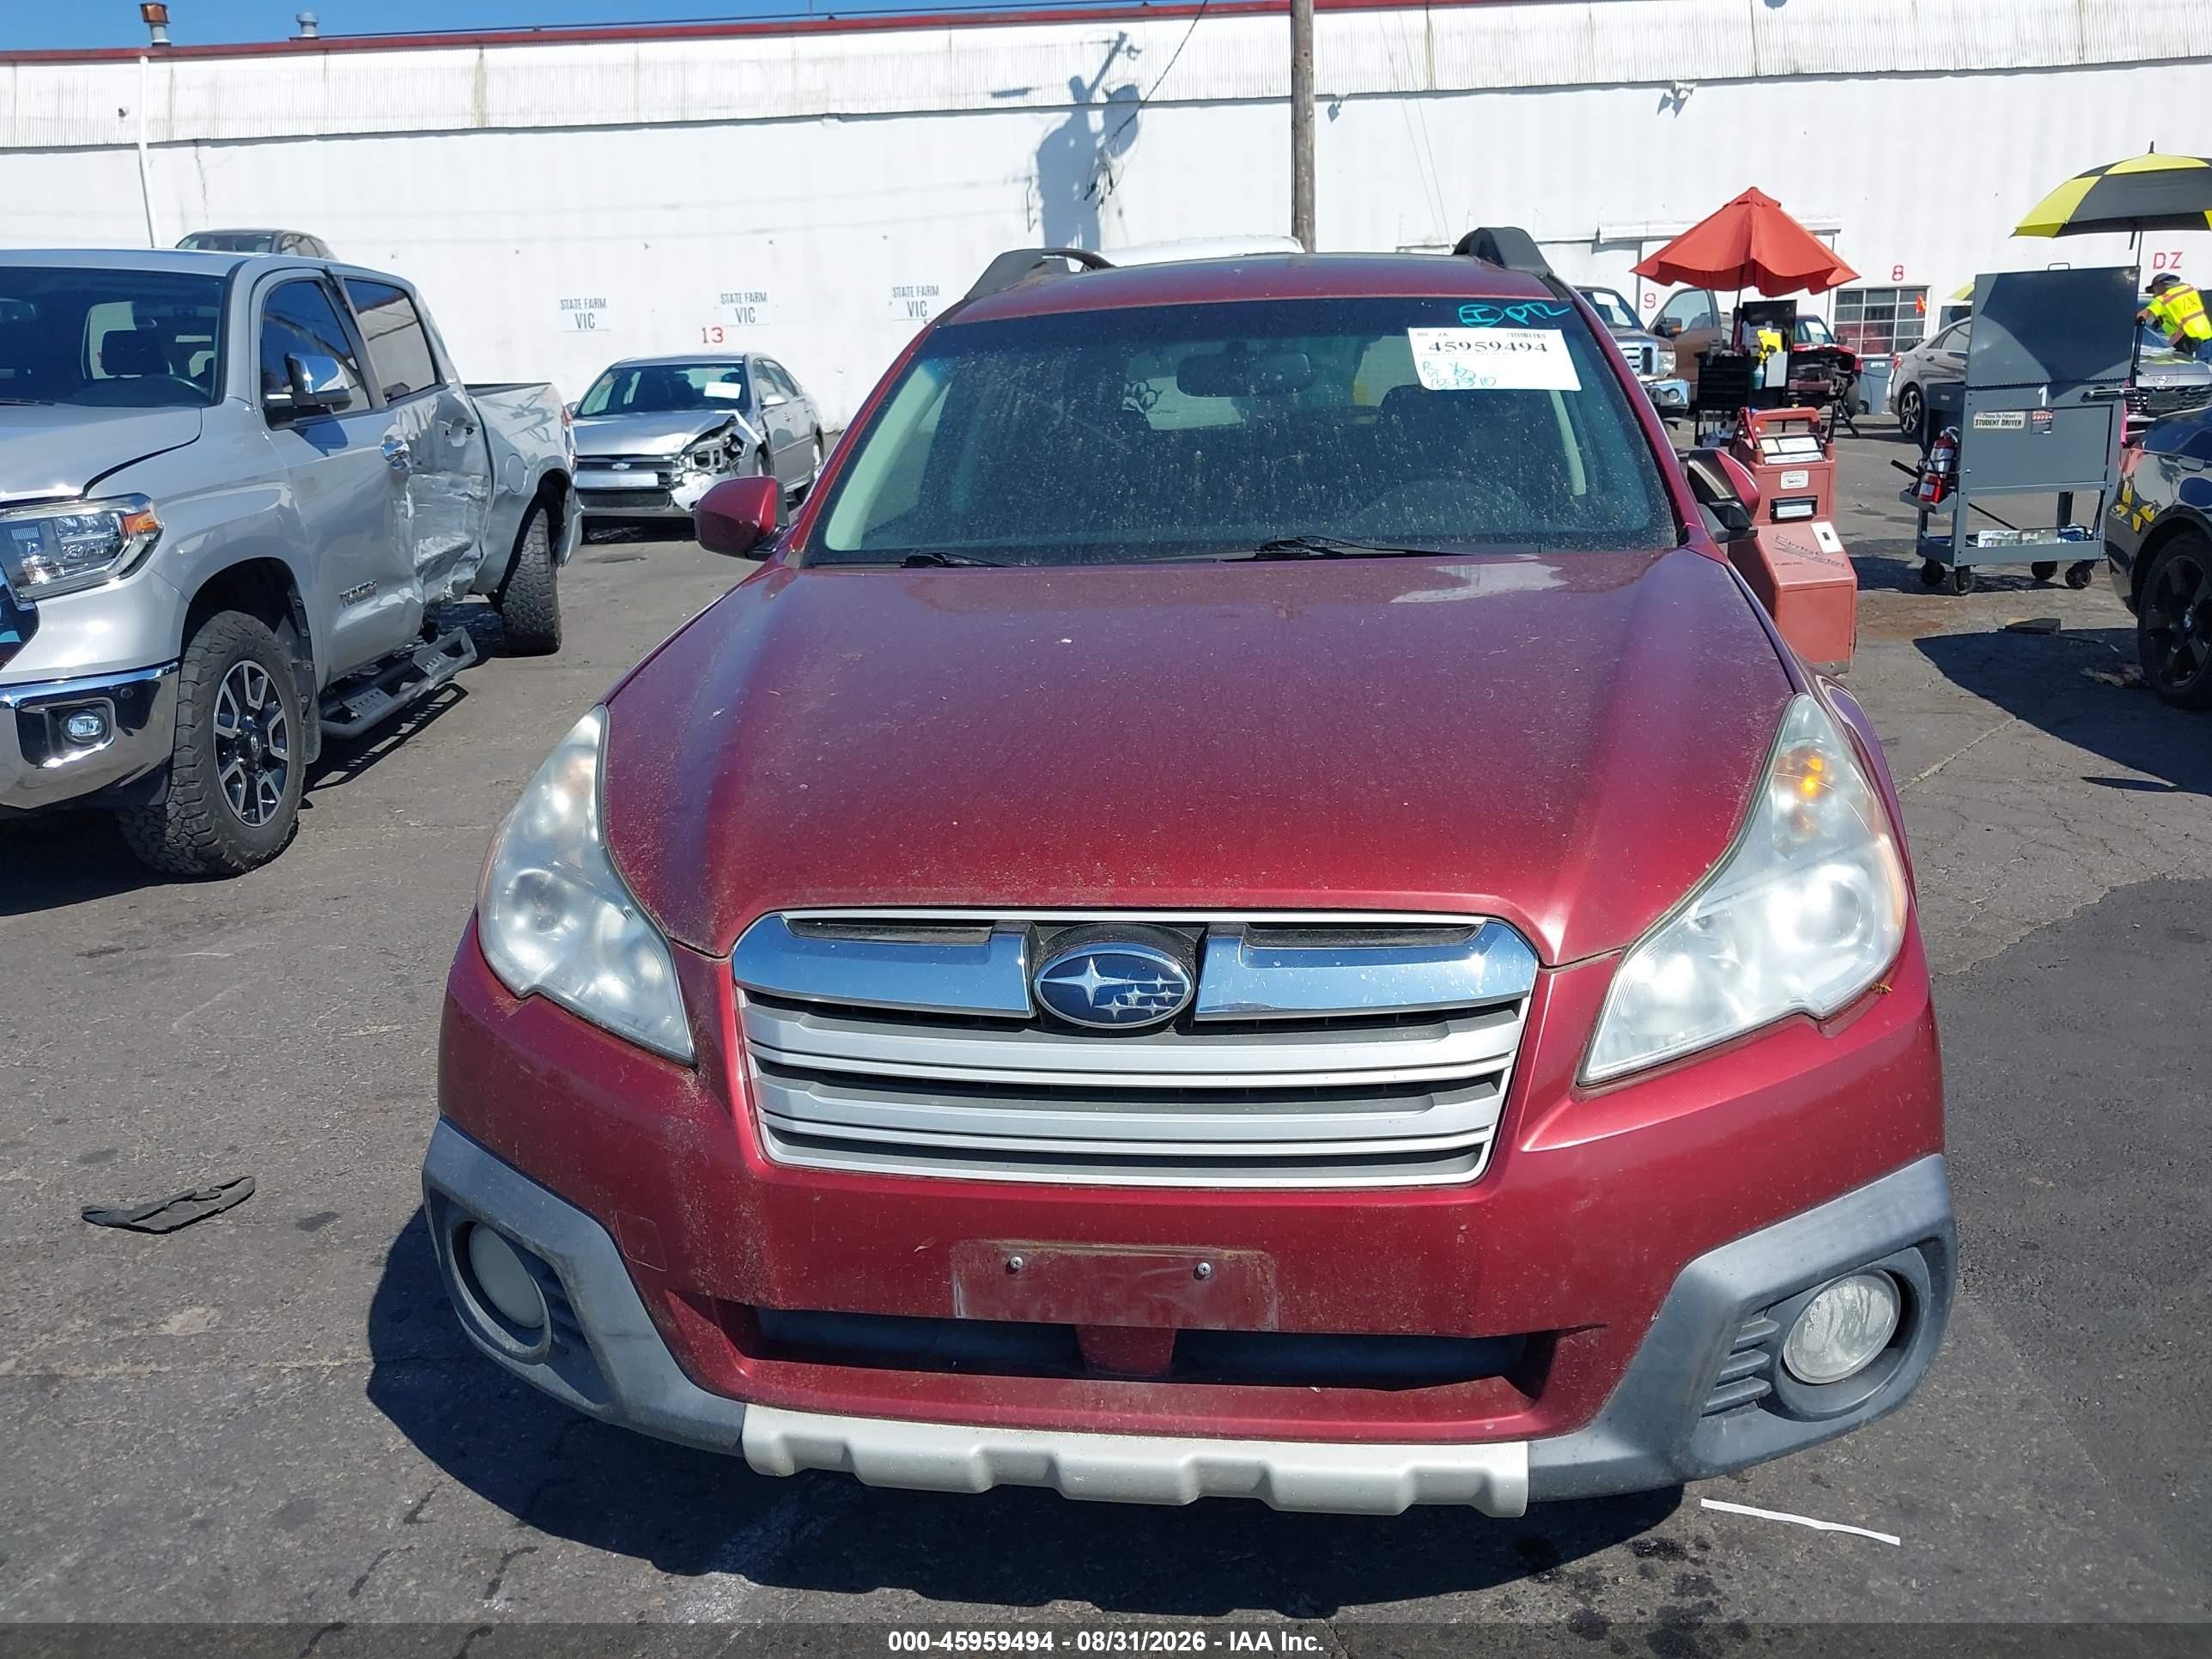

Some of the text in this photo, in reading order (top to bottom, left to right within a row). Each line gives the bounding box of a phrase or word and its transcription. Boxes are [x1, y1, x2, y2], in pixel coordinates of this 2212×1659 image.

[1892, 264, 1904, 282] 8
[720, 290, 769, 305] STATE FARM
[893, 284, 940, 299] STATE FARM
[560, 297, 607, 310] STATE FARM
[906, 300, 927, 318] VIC
[1644, 292, 1656, 309] 9
[574, 312, 596, 330] VIC
[734, 306, 757, 324] VIC
[702, 326, 724, 344] 13
[1428, 341, 1549, 353] 45959494
[2038, 384, 2048, 407] 1
[1975, 418, 2000, 427] STUDENT
